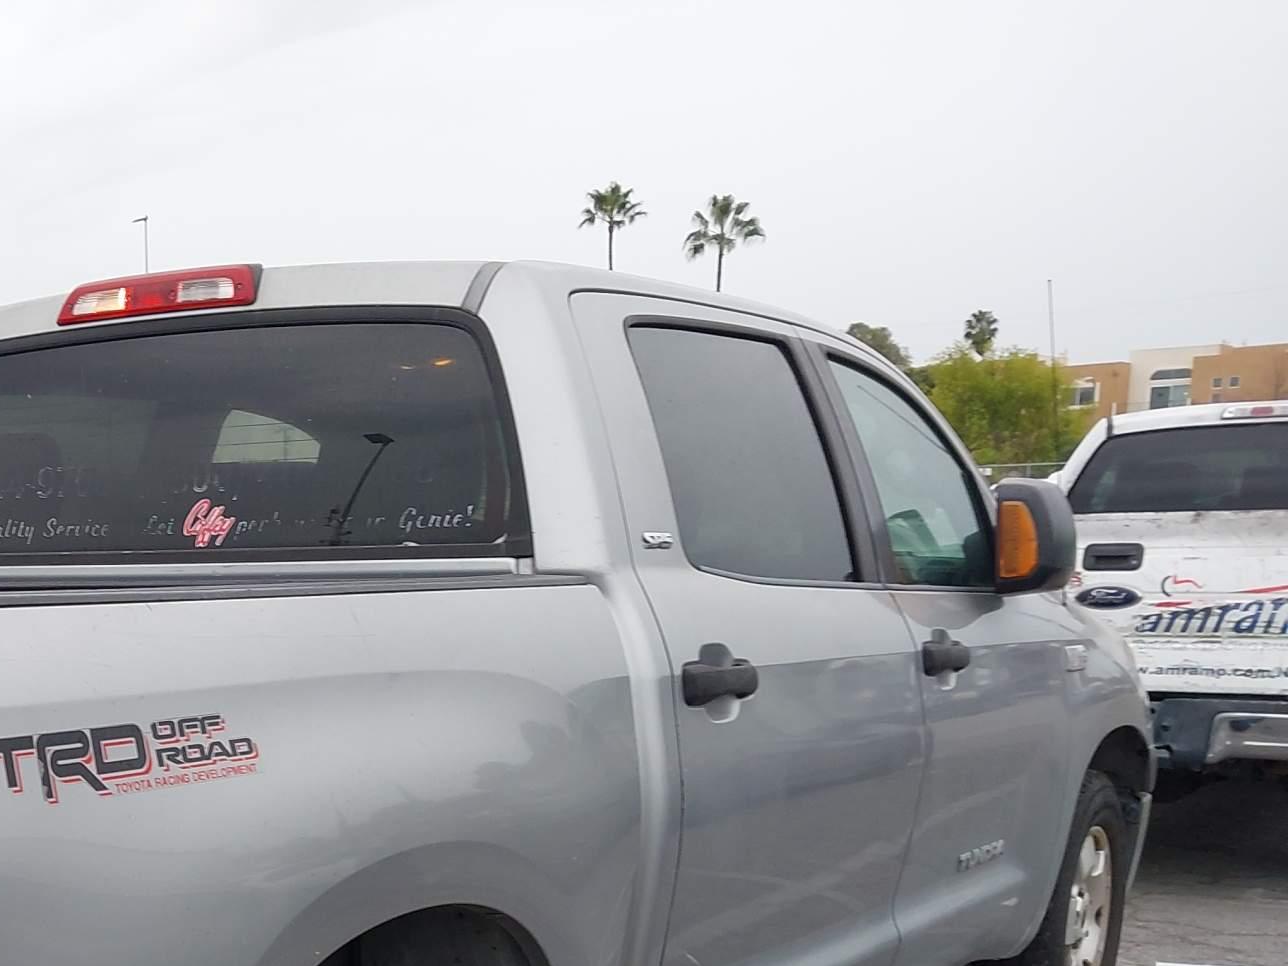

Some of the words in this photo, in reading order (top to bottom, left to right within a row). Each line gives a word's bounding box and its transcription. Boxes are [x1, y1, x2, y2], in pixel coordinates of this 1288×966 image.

[42, 517, 110, 539] Service
[399, 504, 476, 534] Genie!
[150, 713, 225, 745] OFF
[154, 737, 260, 772] ROAD
[114, 780, 154, 795] TOYOTA
[155, 773, 191, 791] RACING
[192, 763, 258, 784] DEVELOPMENT
